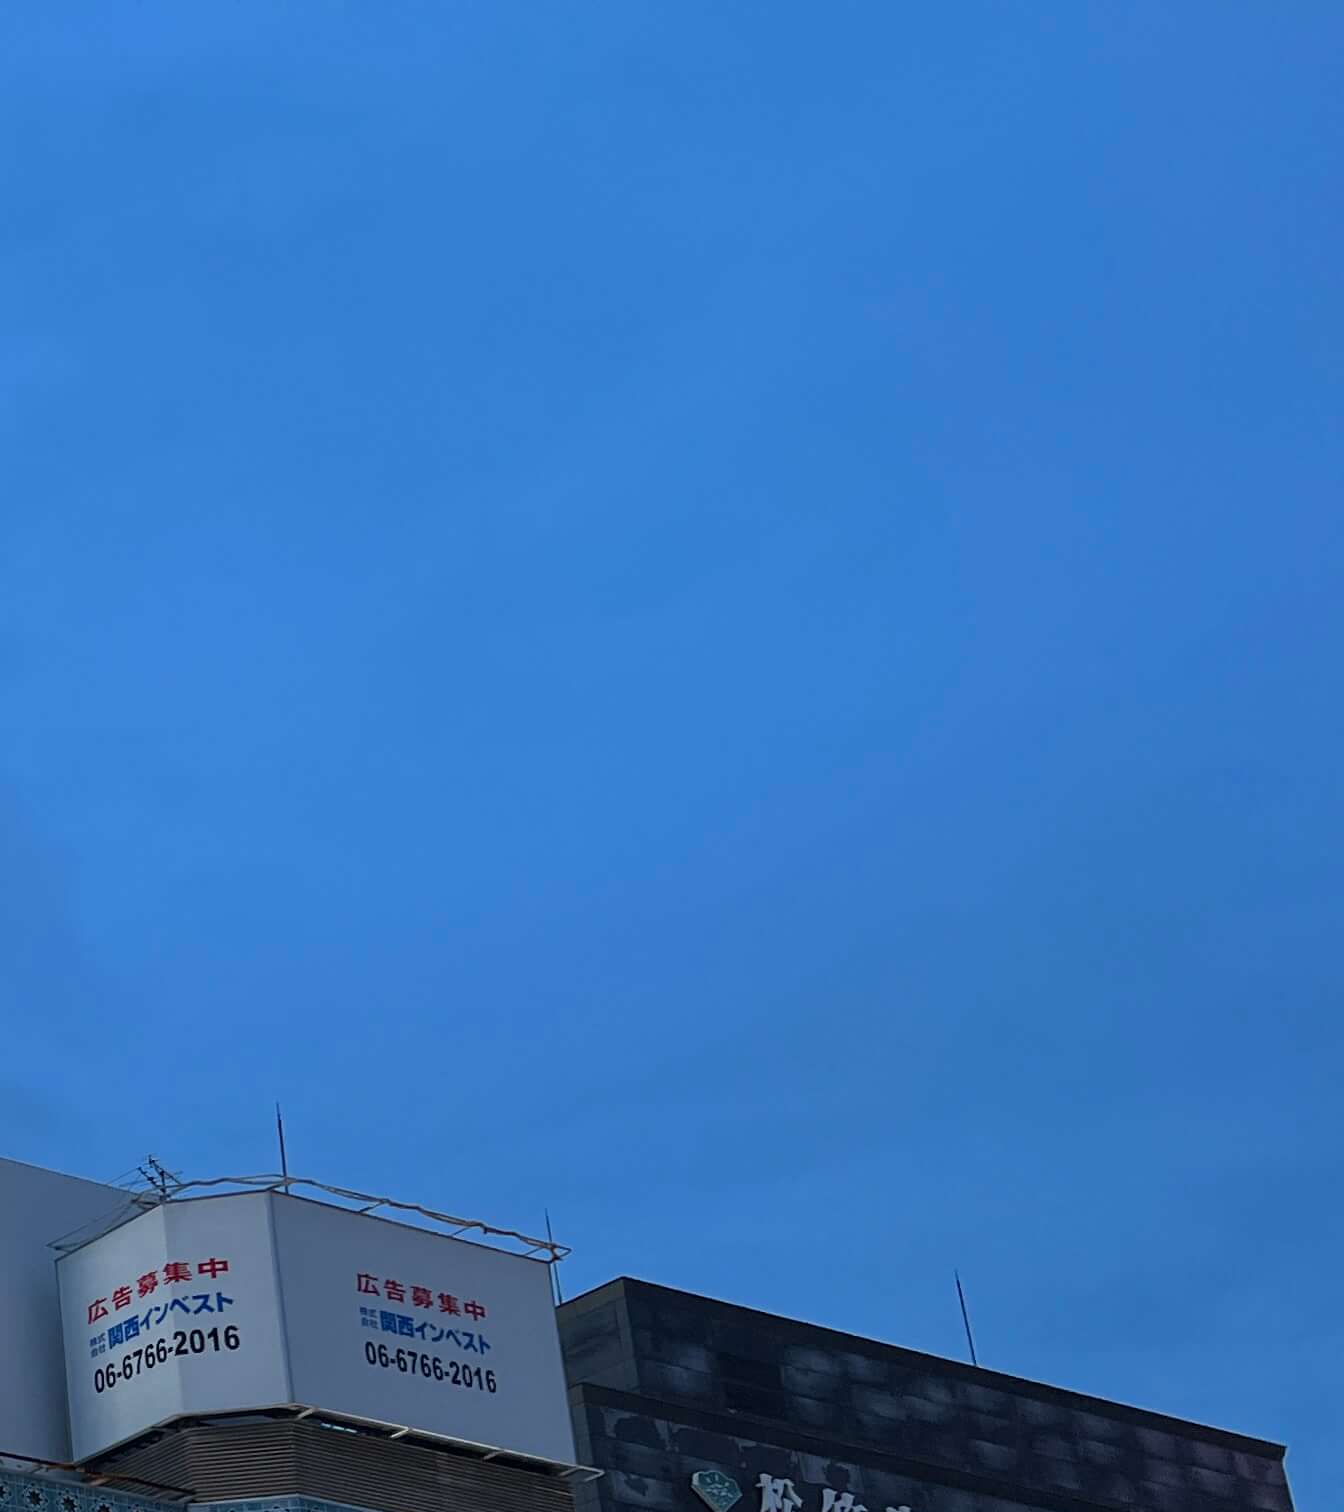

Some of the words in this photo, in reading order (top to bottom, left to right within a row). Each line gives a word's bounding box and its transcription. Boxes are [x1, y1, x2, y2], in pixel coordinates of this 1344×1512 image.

[87, 1257, 230, 1325] 広告募集中
[356, 1272, 488, 1322] 広告募集中
[108, 1291, 233, 1350] 関西インベスト
[380, 1310, 491, 1356] 関西インベスト
[94, 1325, 240, 1393] 06-6766-2016
[364, 1340, 497, 1394] 06-6766-2016
